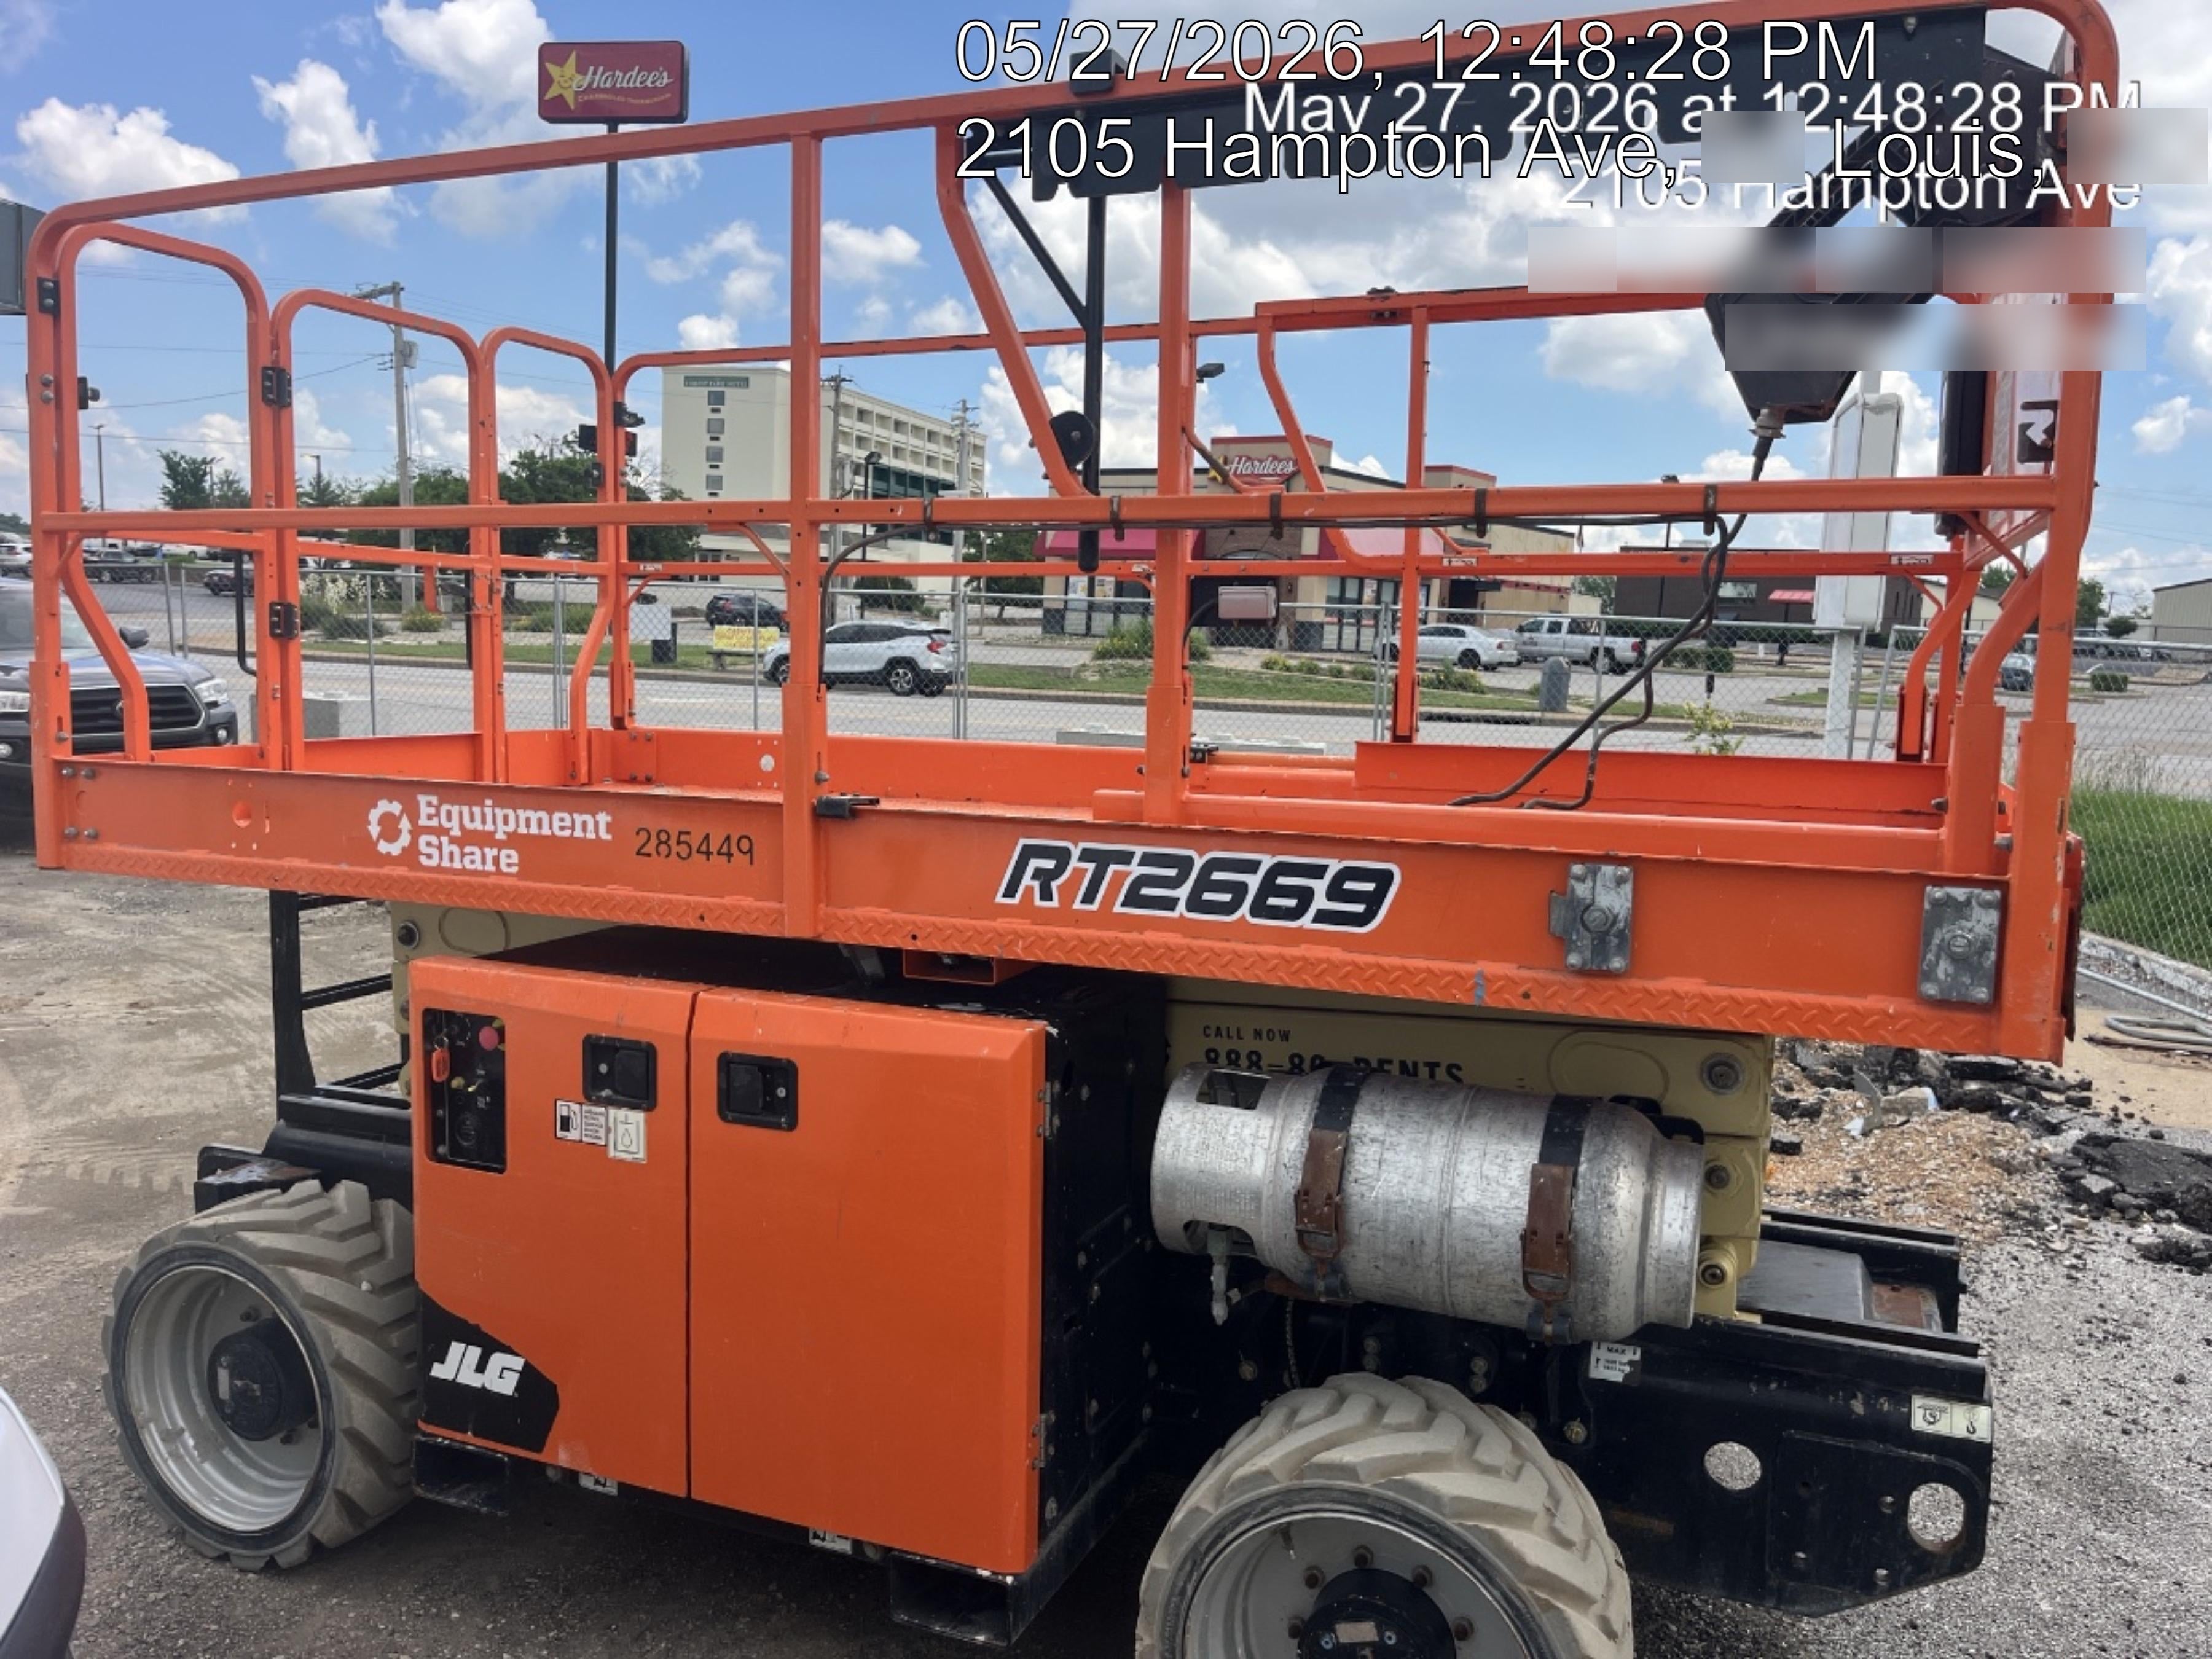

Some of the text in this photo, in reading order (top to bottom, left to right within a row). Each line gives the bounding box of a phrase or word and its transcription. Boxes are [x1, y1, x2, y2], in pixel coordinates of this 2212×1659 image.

[572, 65, 673, 91] Hardee's
[417, 794, 613, 841] Equipment
[418, 834, 519, 873] Share
[635, 827, 755, 866] 285449
[994, 838, 1402, 934] RT2669
[1203, 1025, 1291, 1043] CALL NOW
[430, 1341, 526, 1397] JLG
